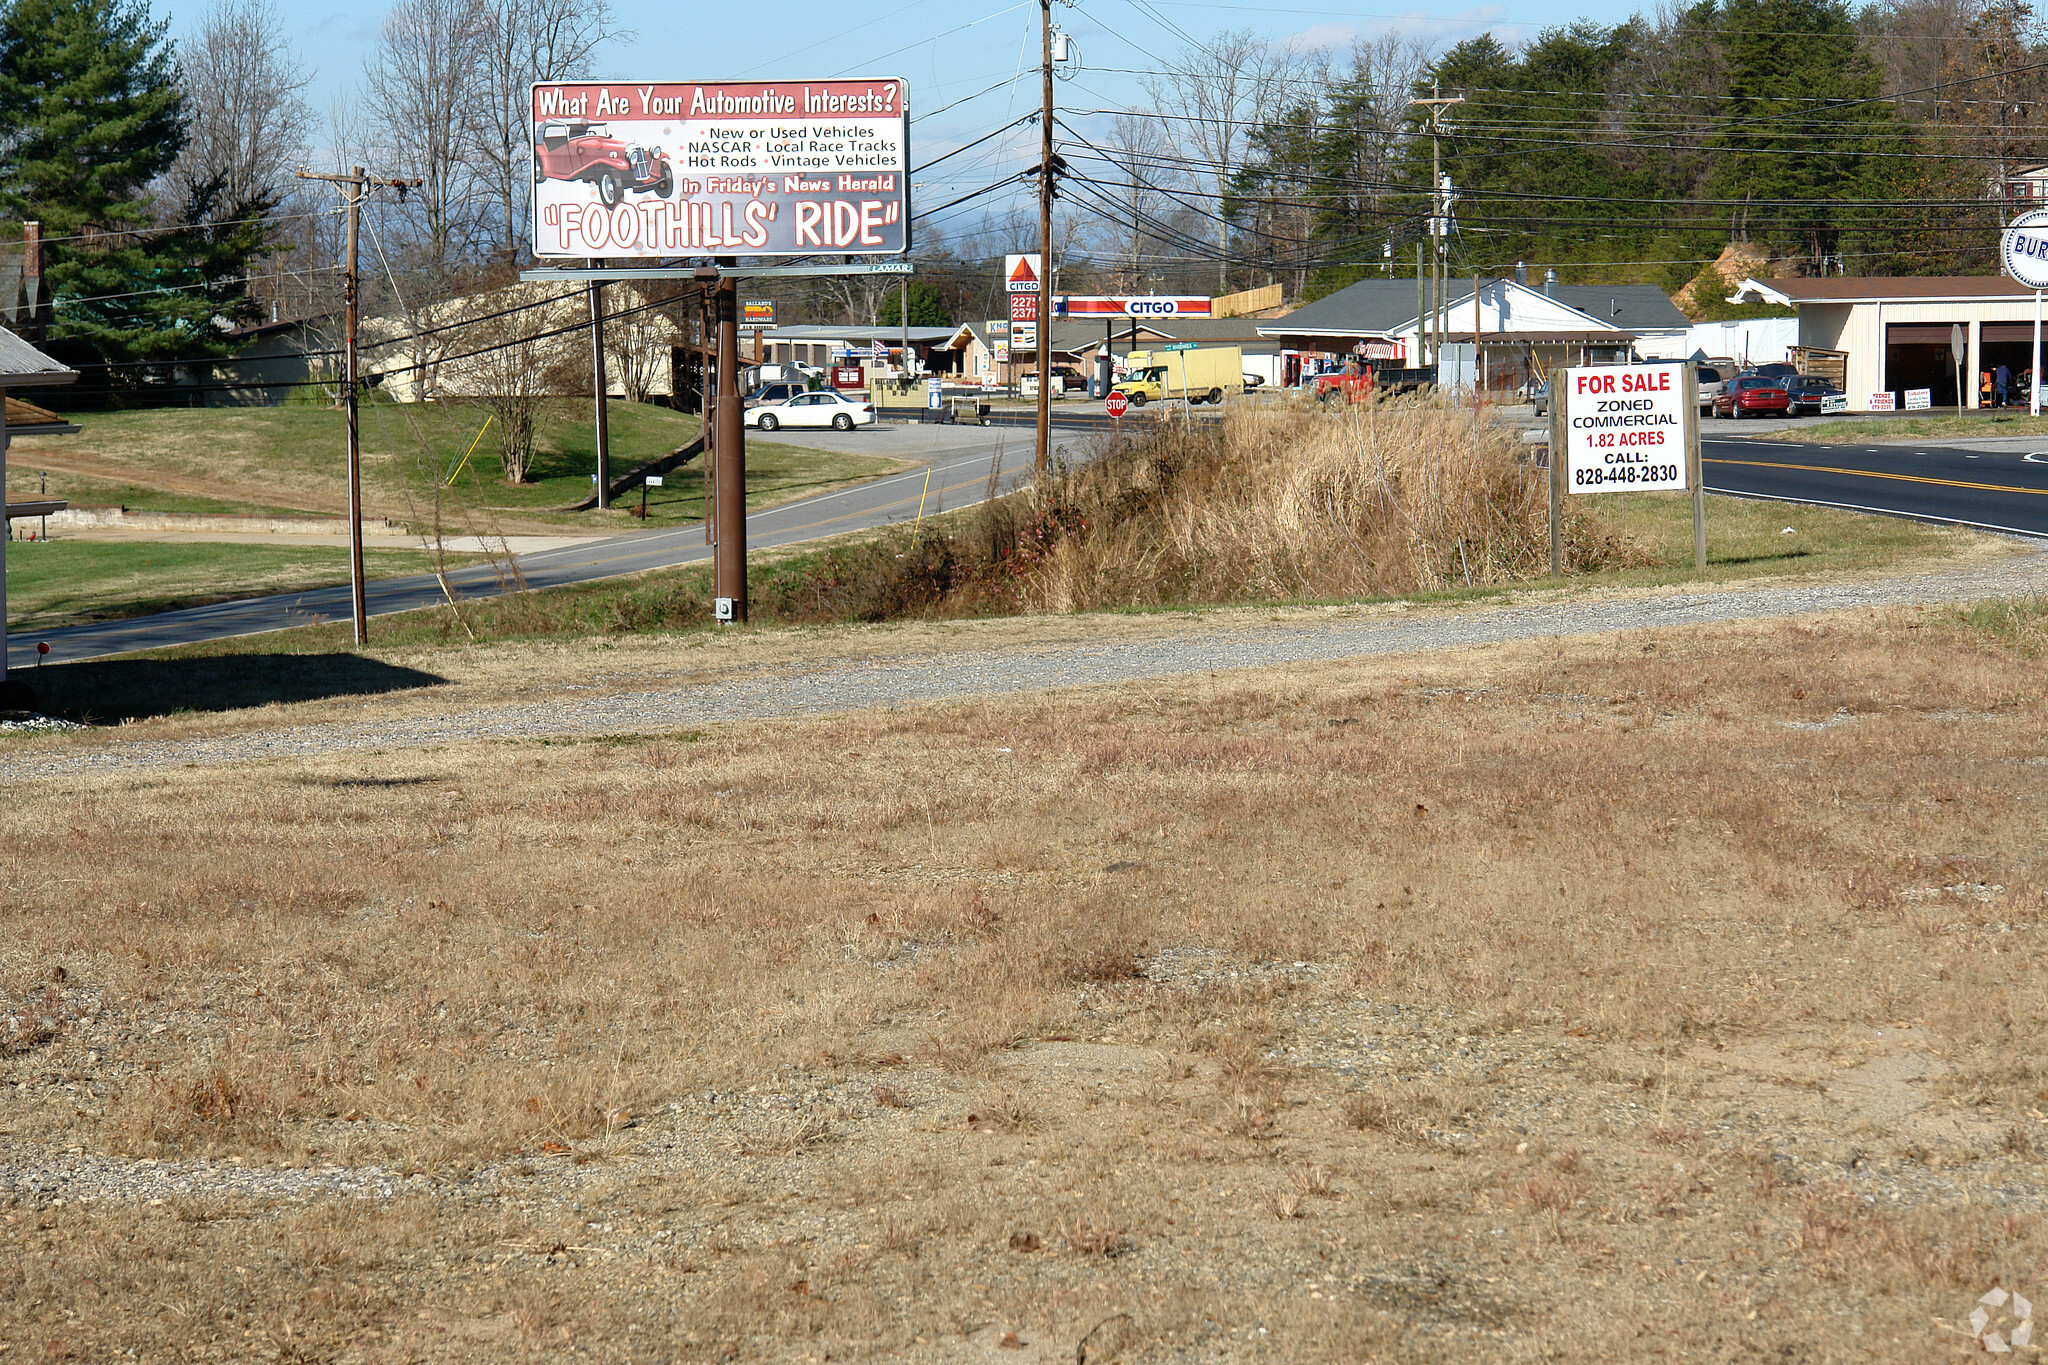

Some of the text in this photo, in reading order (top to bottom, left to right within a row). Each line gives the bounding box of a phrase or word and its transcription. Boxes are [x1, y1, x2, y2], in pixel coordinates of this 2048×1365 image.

[538, 83, 897, 117] What Are Your Automotive Interests?
[709, 126, 875, 139] New or Used Vehicles
[688, 139, 896, 153] NASCAR Local Race Tracks
[688, 153, 897, 168] Hot Rods Vintage Vehicles
[682, 174, 894, 198] in Friday's News Herald
[872, 263, 909, 273] LAMAR
[1010, 282, 1039, 291] CITGO
[1130, 301, 1174, 313] CITGO
[1577, 372, 1670, 394] FOR SALE
[1107, 399, 1126, 410] STOP
[1597, 399, 1653, 413] ZONED
[1573, 414, 1678, 428] COMMERCIAL
[1586, 431, 1665, 448] 1.82 ACRES
[1604, 452, 1649, 464] CALL:
[1576, 464, 1677, 485] 828-448-2830
